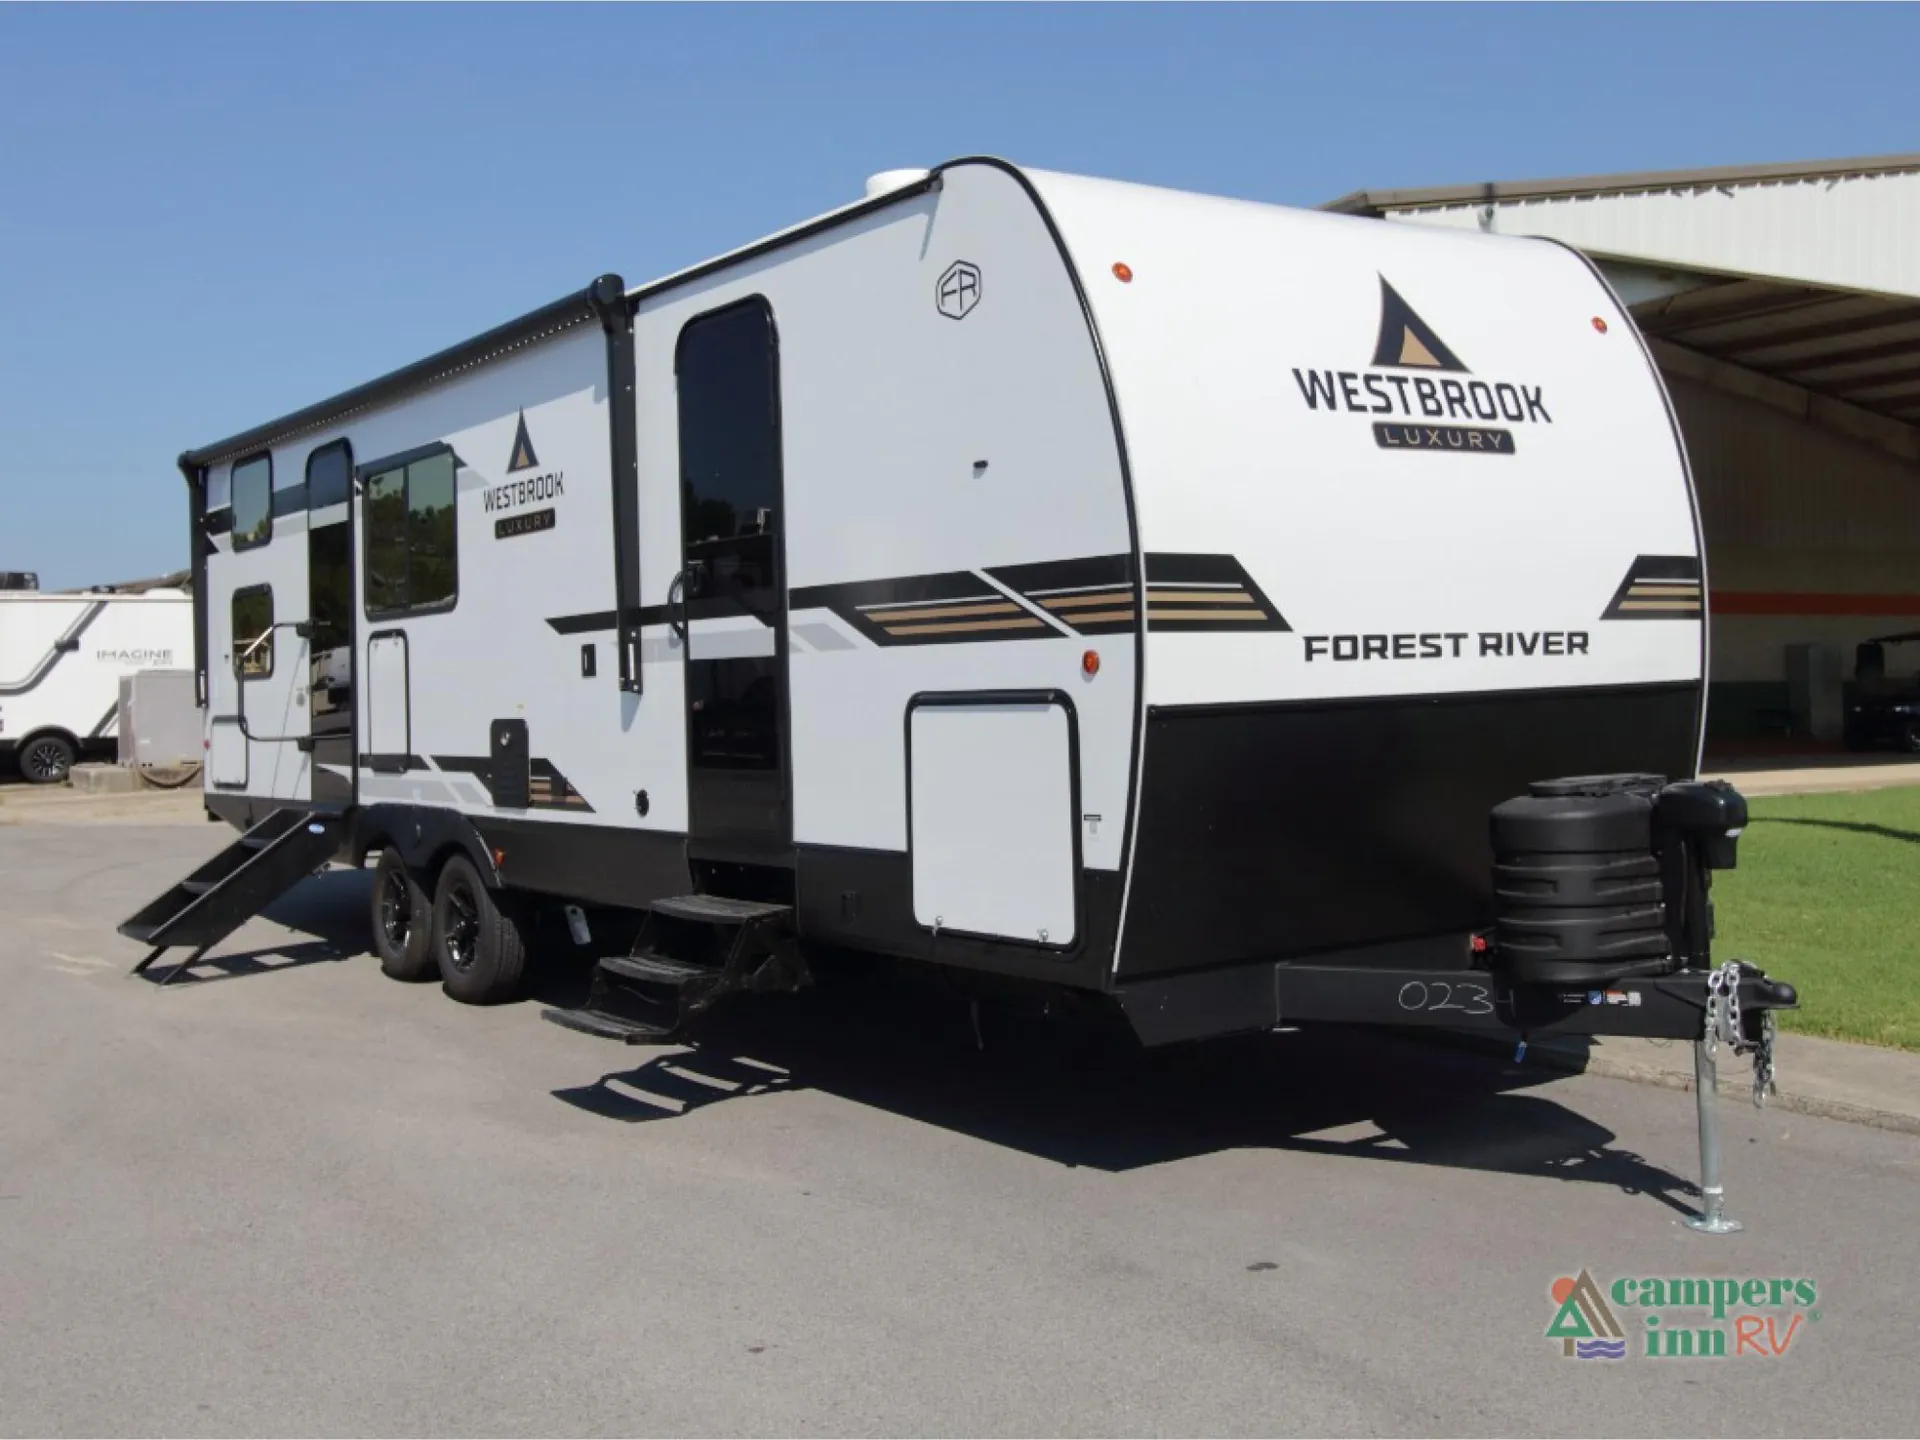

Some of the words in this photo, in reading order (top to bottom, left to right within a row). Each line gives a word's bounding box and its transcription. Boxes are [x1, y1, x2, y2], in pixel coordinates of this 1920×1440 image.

[1292, 367, 1553, 424] WESTBROOK
[1382, 427, 1505, 450] LUXURY
[483, 470, 564, 513] WESTBROOK
[498, 512, 552, 535] LUXURY
[96, 648, 174, 661] IMAGINE
[1303, 632, 1469, 662] FOREST
[1477, 631, 1590, 658] RIVER
